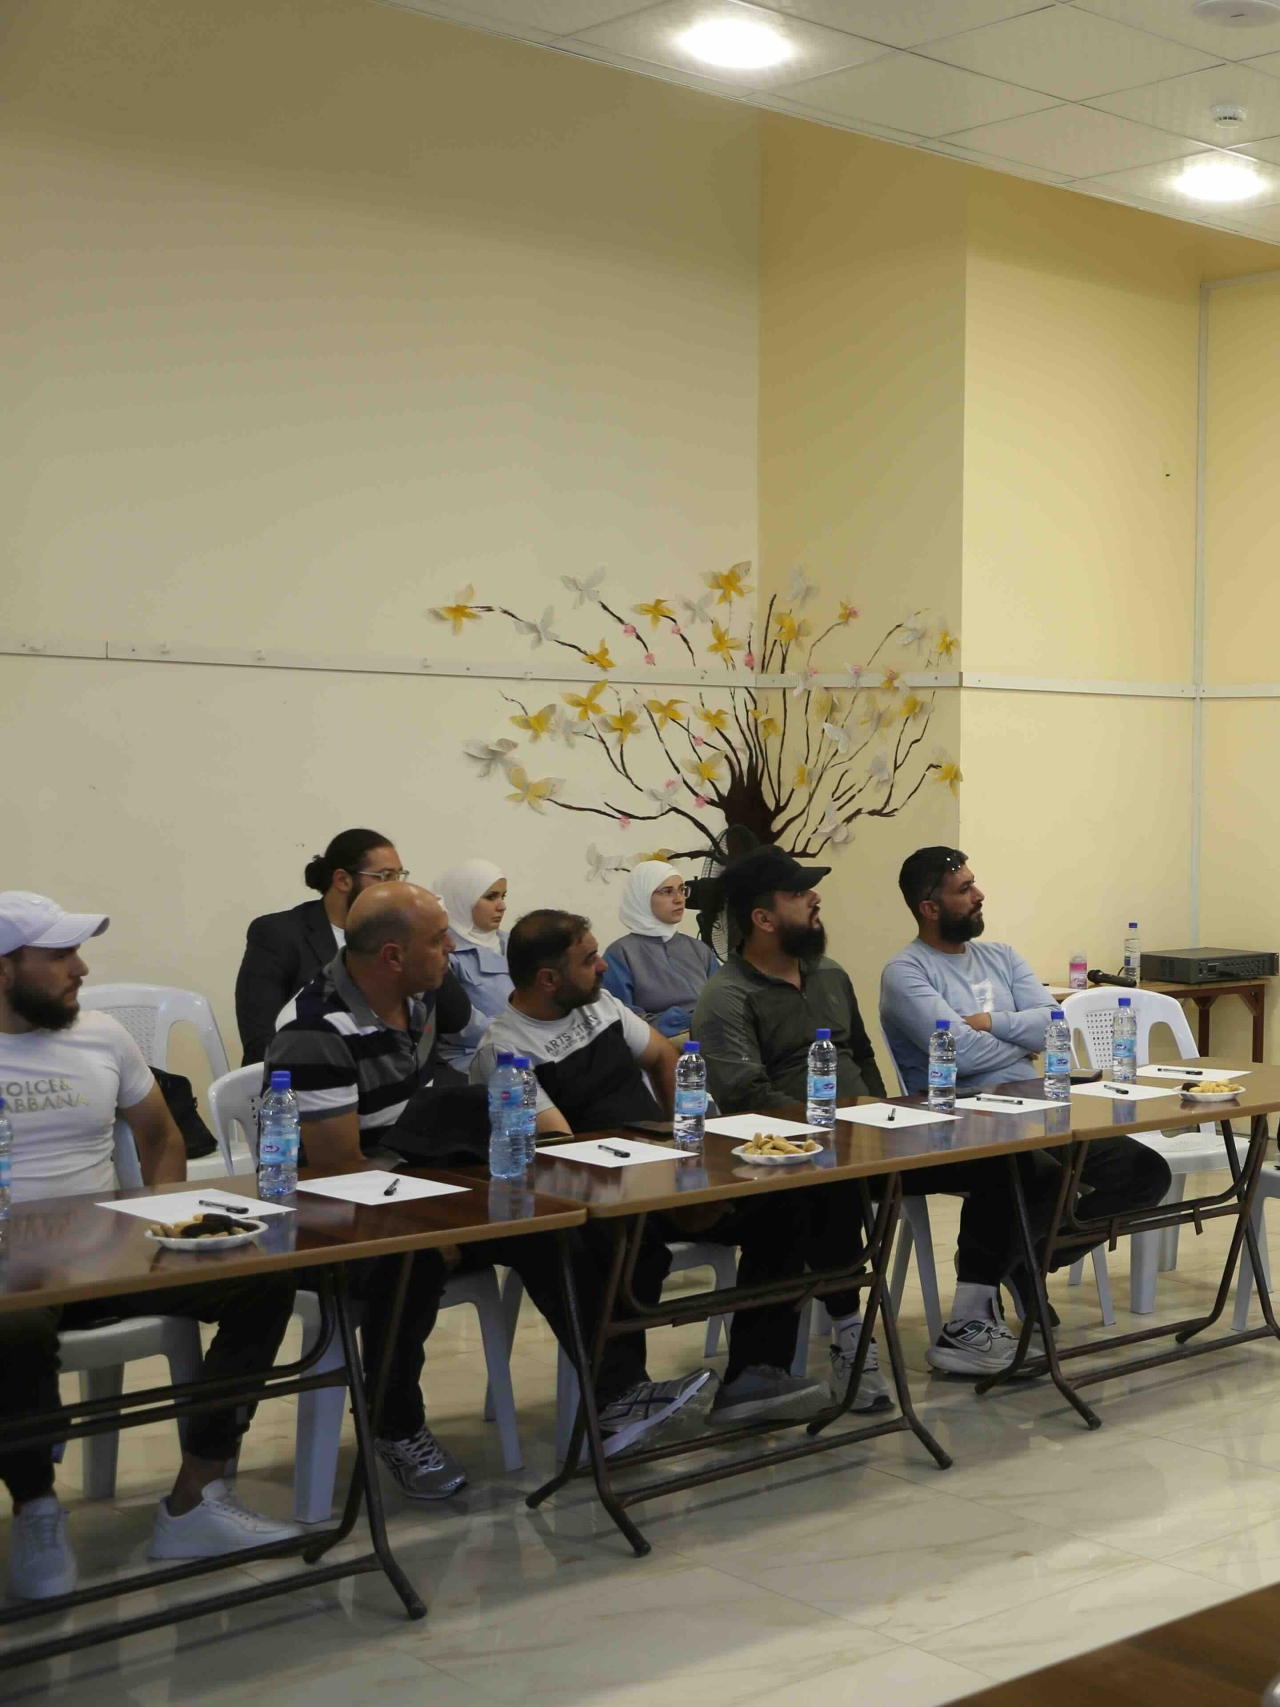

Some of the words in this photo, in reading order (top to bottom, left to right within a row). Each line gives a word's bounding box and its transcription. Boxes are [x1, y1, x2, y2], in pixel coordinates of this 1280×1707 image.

[544, 1032, 571, 1053] ARTS
[0, 1079, 72, 1097] OLCE&
[3, 1093, 91, 1113] ABBANA
